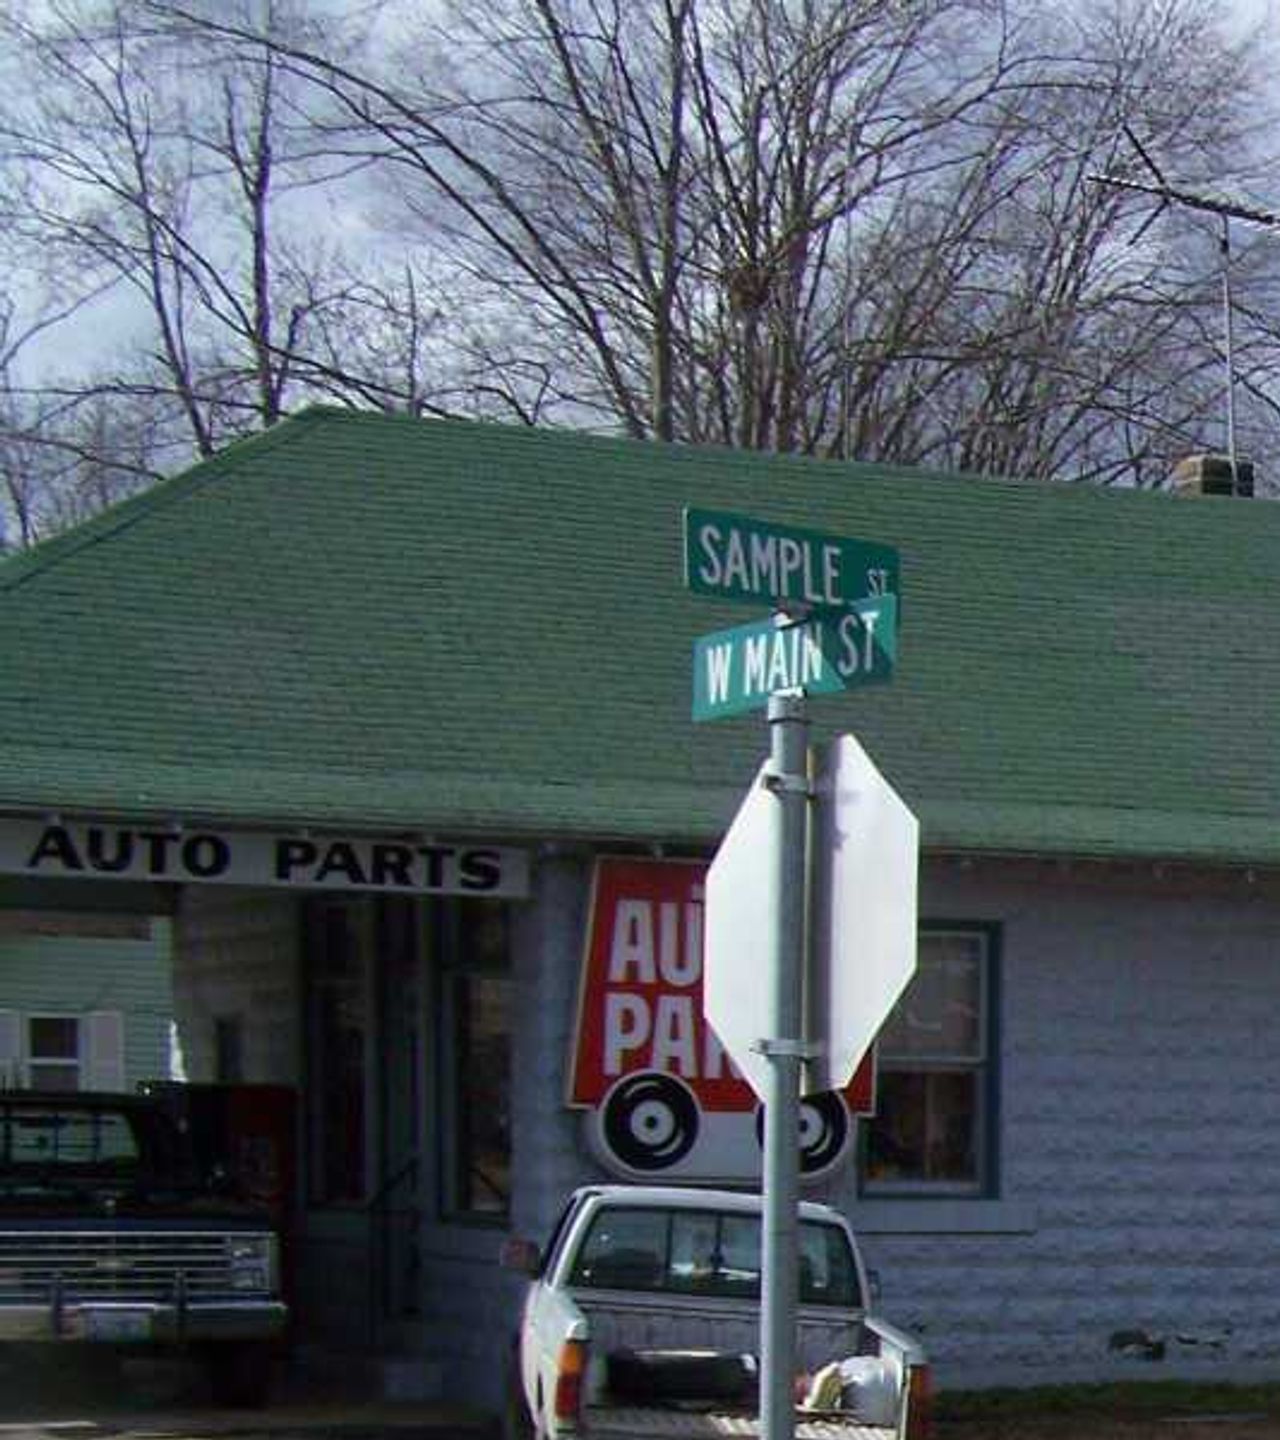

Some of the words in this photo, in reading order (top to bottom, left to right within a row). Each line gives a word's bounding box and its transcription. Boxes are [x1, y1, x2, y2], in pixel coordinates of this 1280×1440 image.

[700, 524, 844, 605] SAMPLE
[867, 568, 888, 597] ST
[707, 642, 732, 705] W
[744, 620, 823, 697] MAIN
[837, 611, 880, 676] ST
[26, 825, 231, 878] AUTO
[275, 834, 502, 891] PARTS
